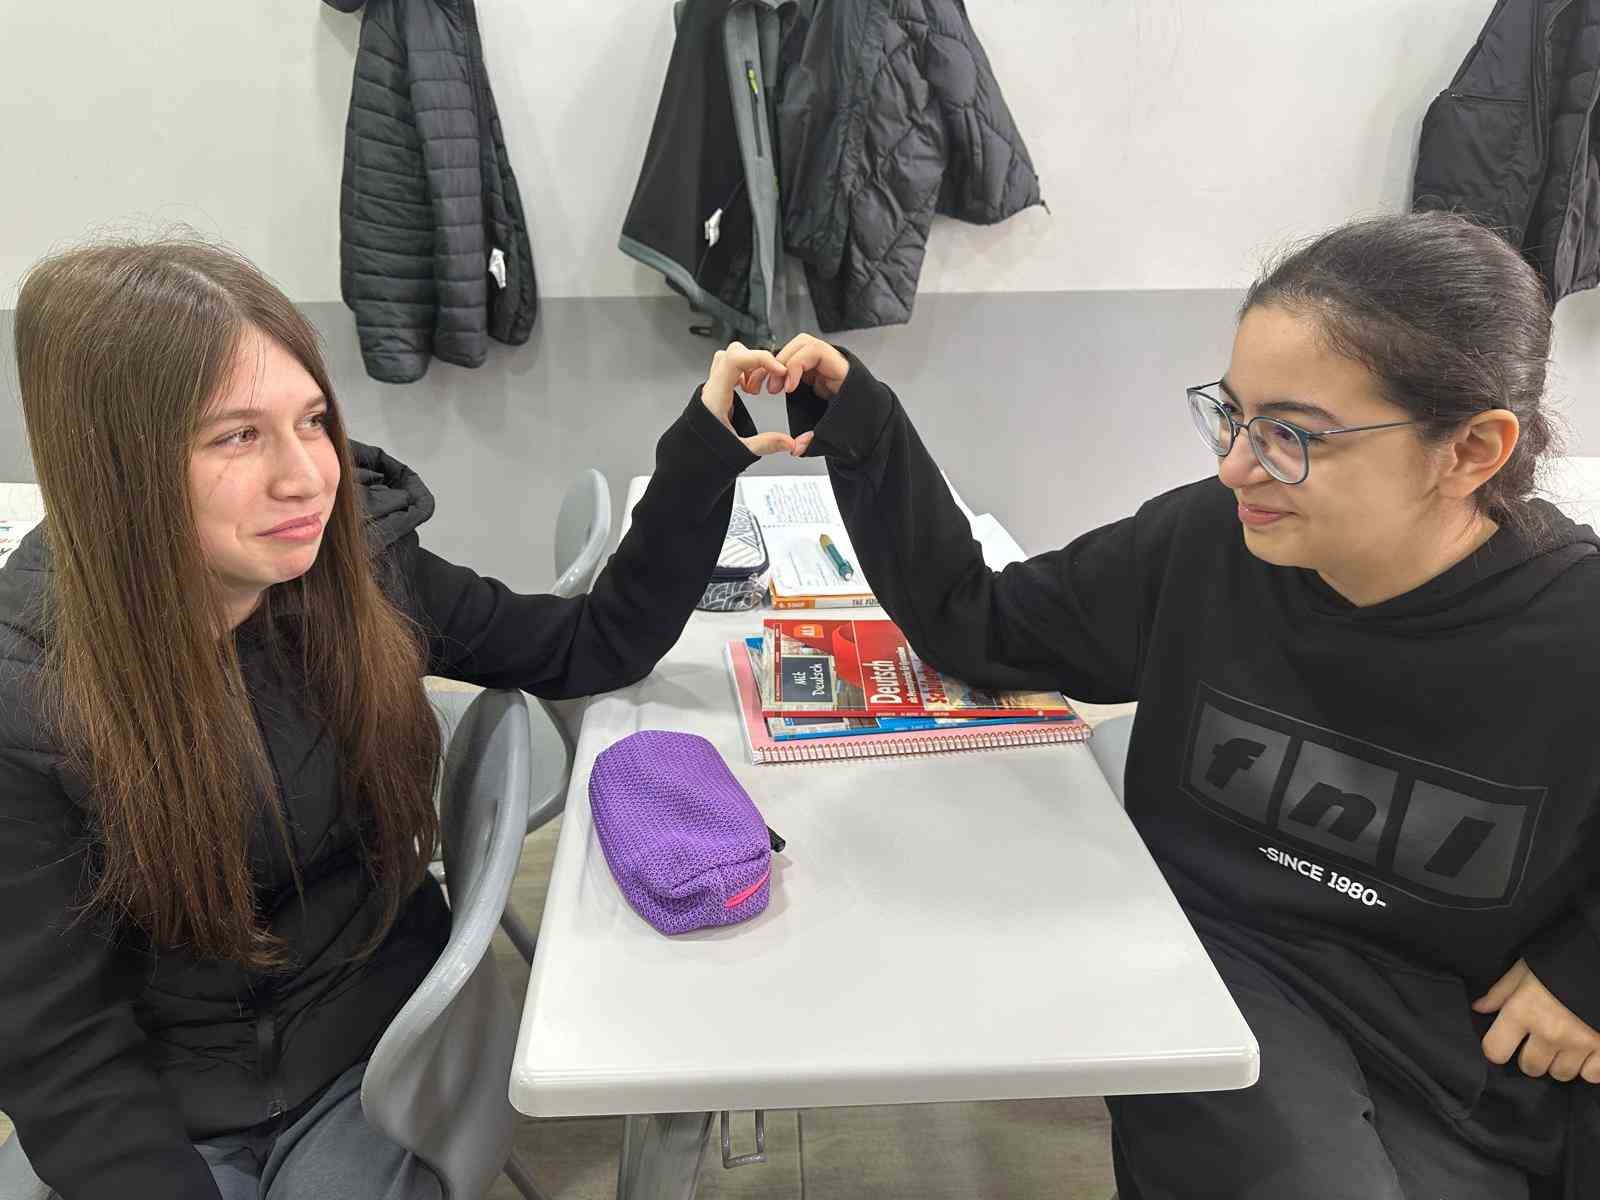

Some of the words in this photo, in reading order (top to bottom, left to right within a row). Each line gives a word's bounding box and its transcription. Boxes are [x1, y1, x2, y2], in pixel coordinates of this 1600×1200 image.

[792, 671, 807, 687] Mit
[809, 663, 825, 697] Deutsch
[861, 660, 903, 704] Deutsch
